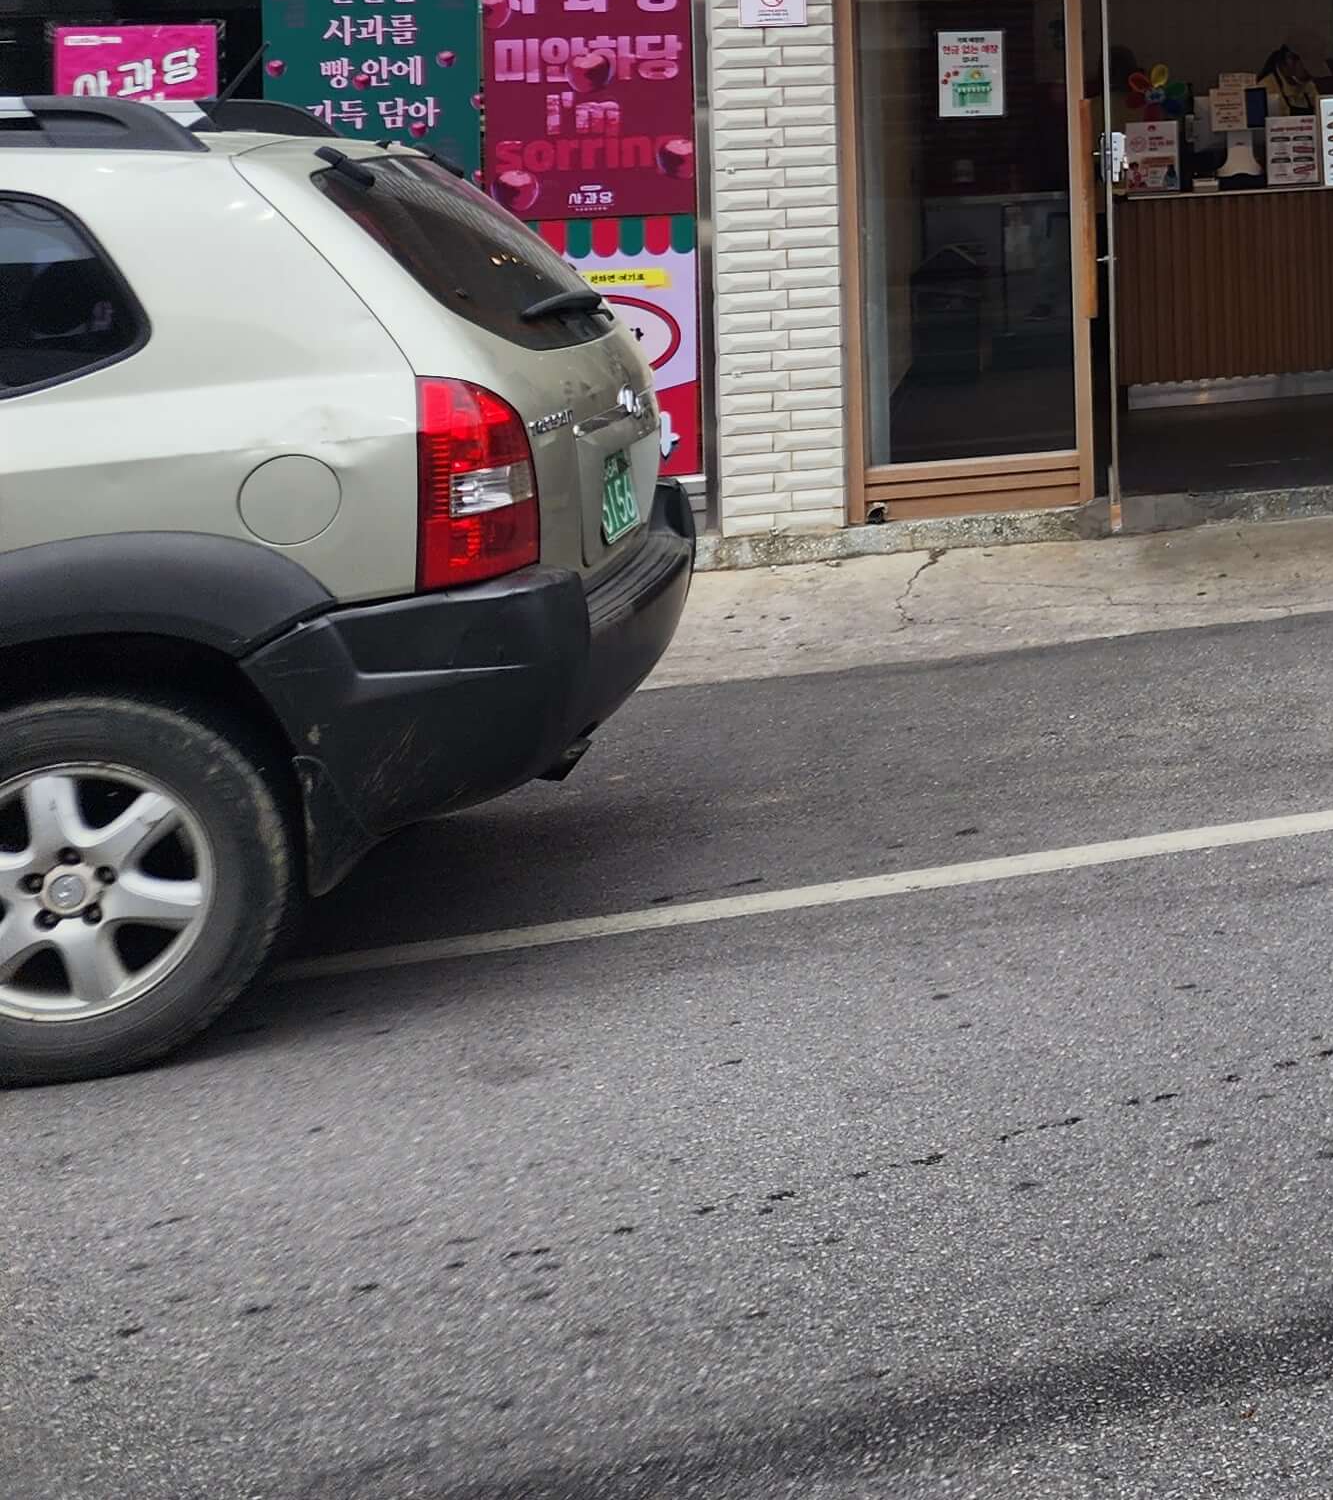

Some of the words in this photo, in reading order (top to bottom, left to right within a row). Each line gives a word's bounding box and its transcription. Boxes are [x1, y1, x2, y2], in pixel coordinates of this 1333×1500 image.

[322, 14, 418, 46] 사과를
[72, 47, 201, 97] 사과당
[320, 57, 355, 89] 빵
[361, 55, 424, 87] 안에
[494, 34, 682, 84] 미안하당
[306, 99, 369, 130] 가득
[377, 97, 441, 129] 담아
[495, 134, 691, 178] sorrin
